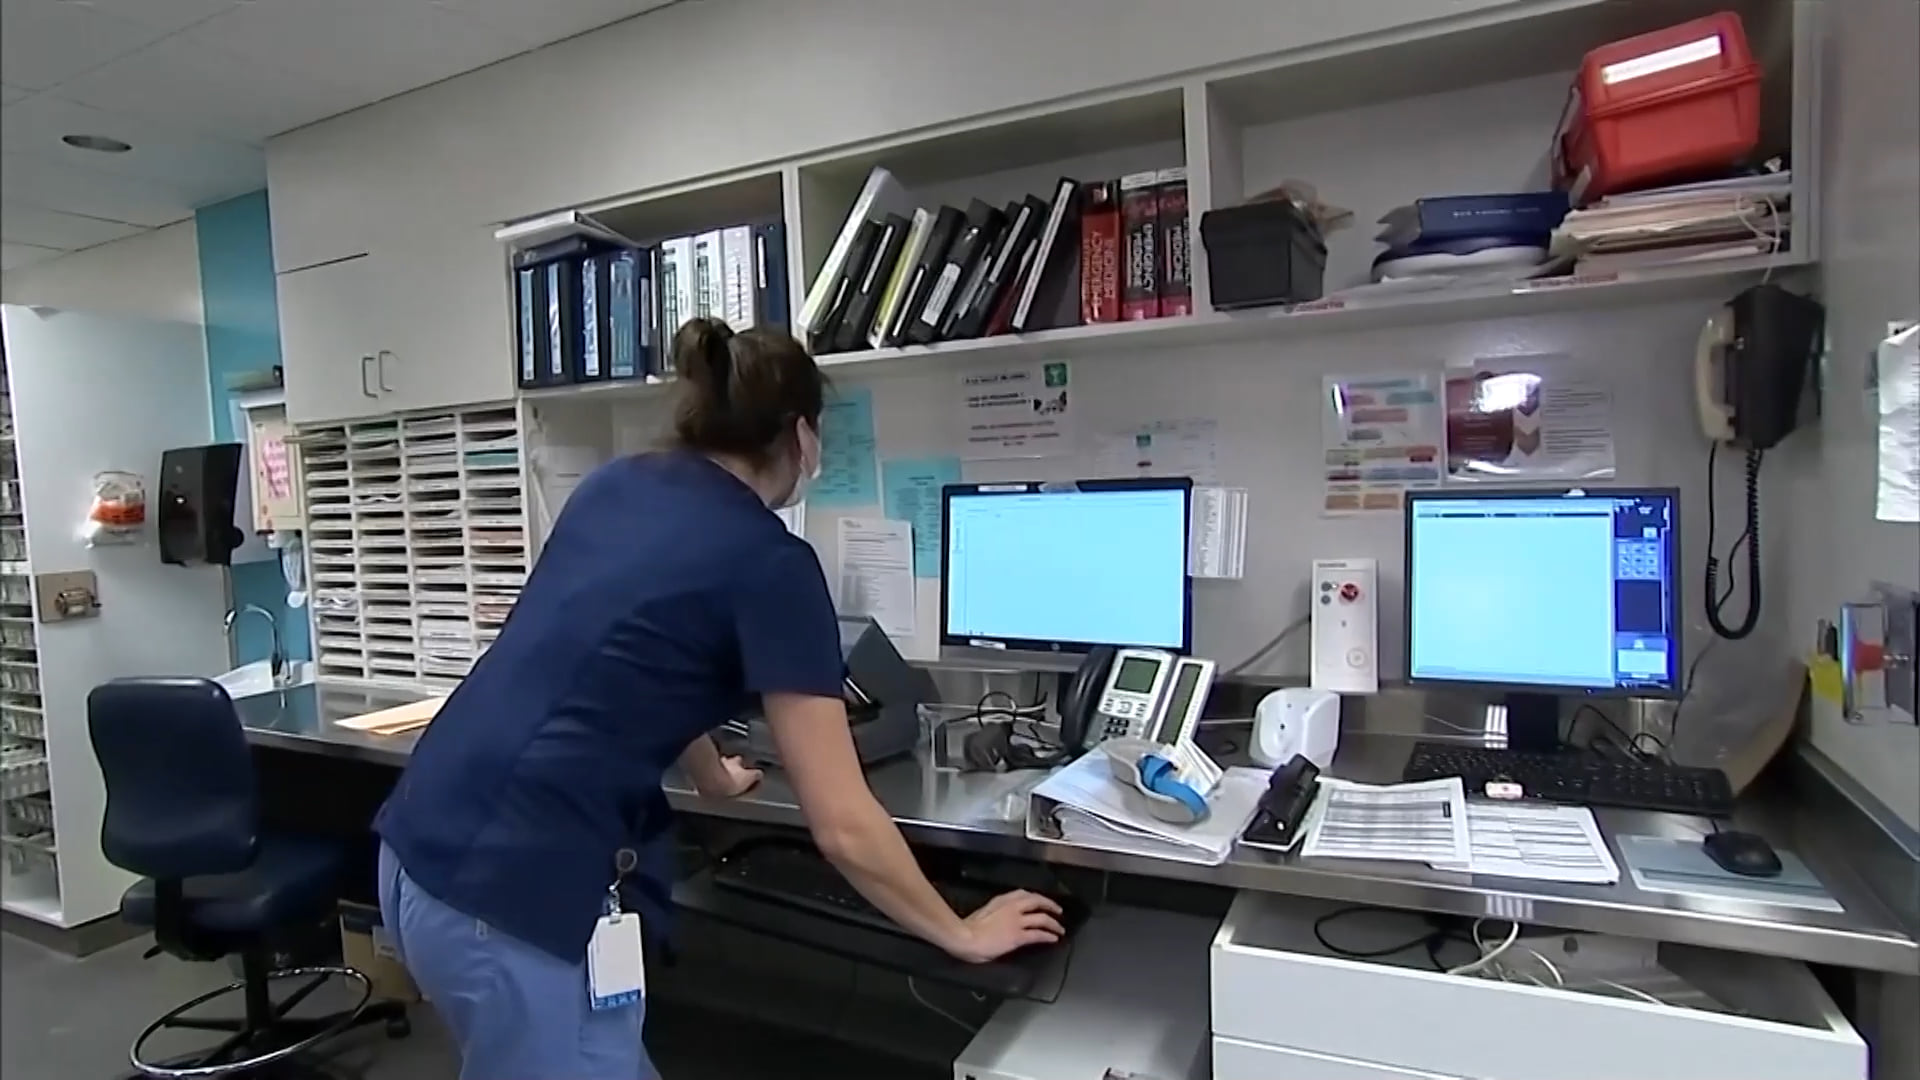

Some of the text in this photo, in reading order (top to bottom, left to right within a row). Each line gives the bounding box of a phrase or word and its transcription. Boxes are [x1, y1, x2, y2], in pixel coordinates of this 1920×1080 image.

[1091, 231, 1103, 306] EMERGENCY
[1133, 232, 1143, 287] MEDICINE
[1142, 223, 1154, 292] EMERGENCY
[1172, 225, 1183, 281] MEDICINE
